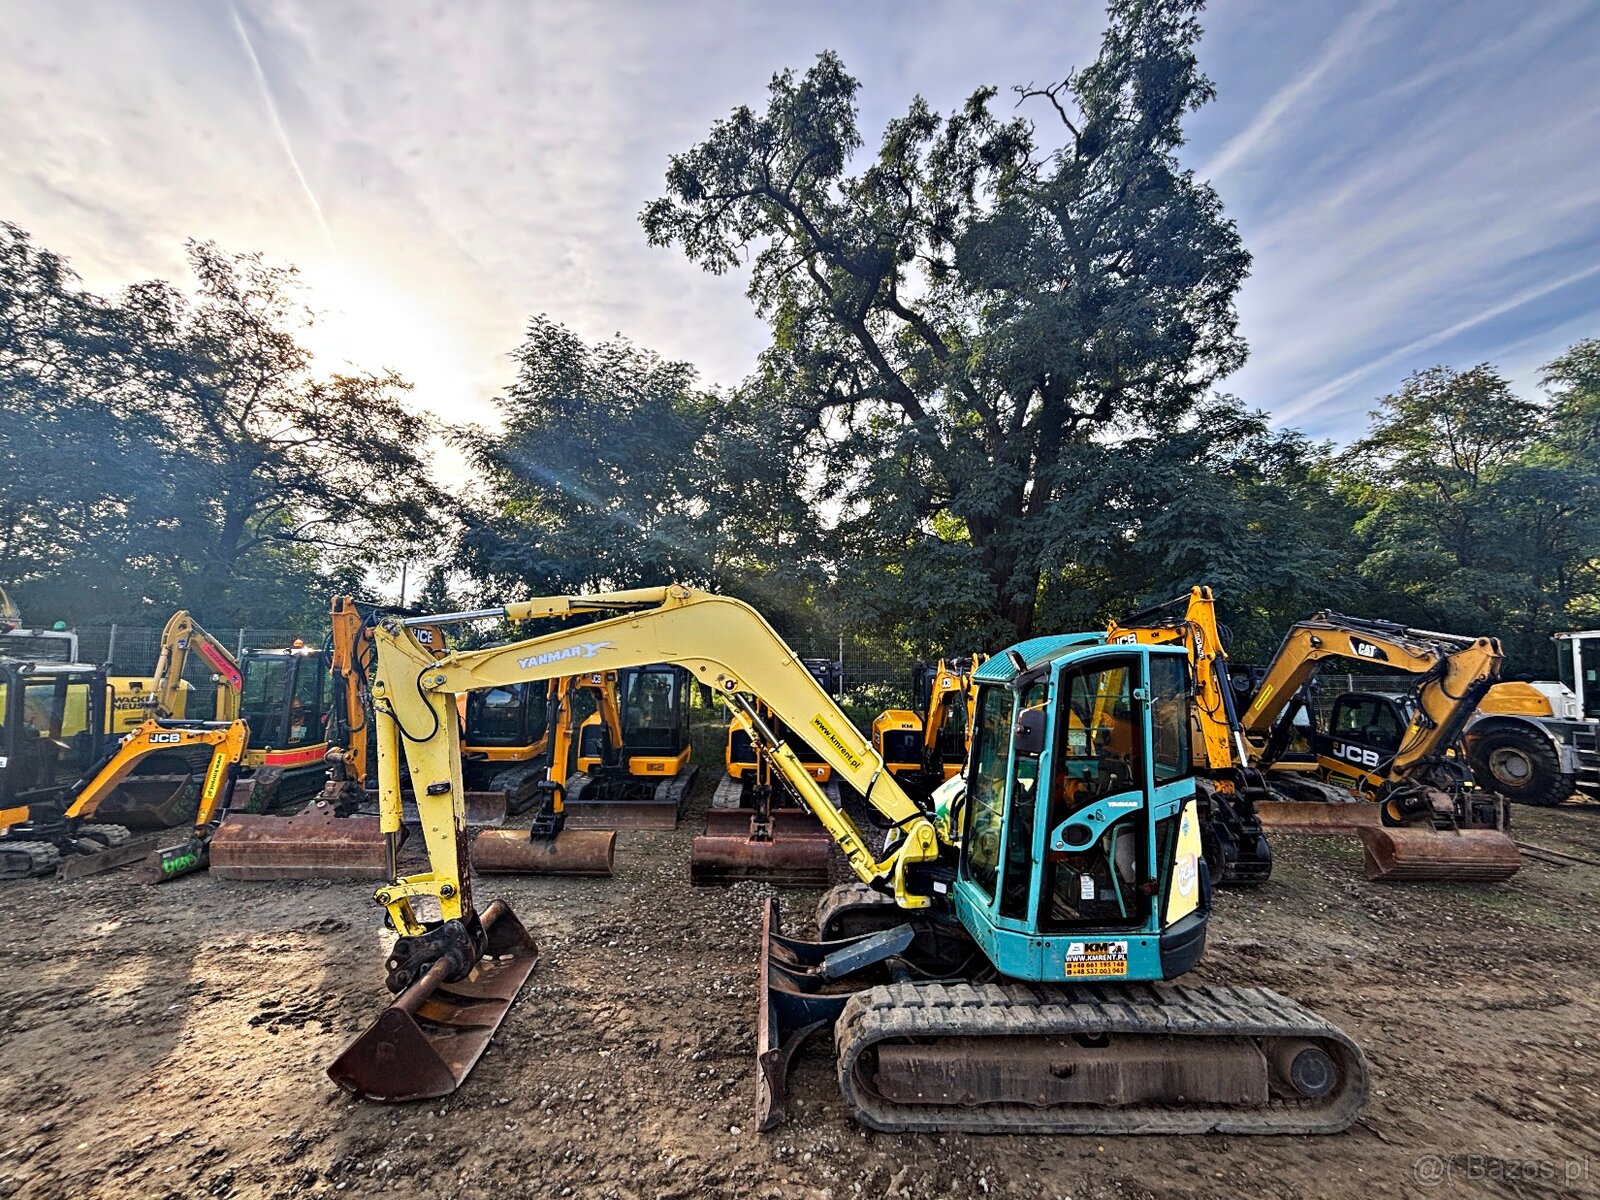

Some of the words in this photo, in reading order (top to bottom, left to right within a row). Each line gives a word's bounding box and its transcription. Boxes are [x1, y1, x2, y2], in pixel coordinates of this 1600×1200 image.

[518, 645, 581, 669] YANMAR
[1358, 643, 1376, 657] CAT
[149, 733, 181, 743] JCB
[814, 718, 861, 769] www.kmrent.pl
[1332, 743, 1379, 767] JCB
[1084, 943, 1108, 952] KM
[1065, 954, 1127, 962] WWW.KMRENT.PL
